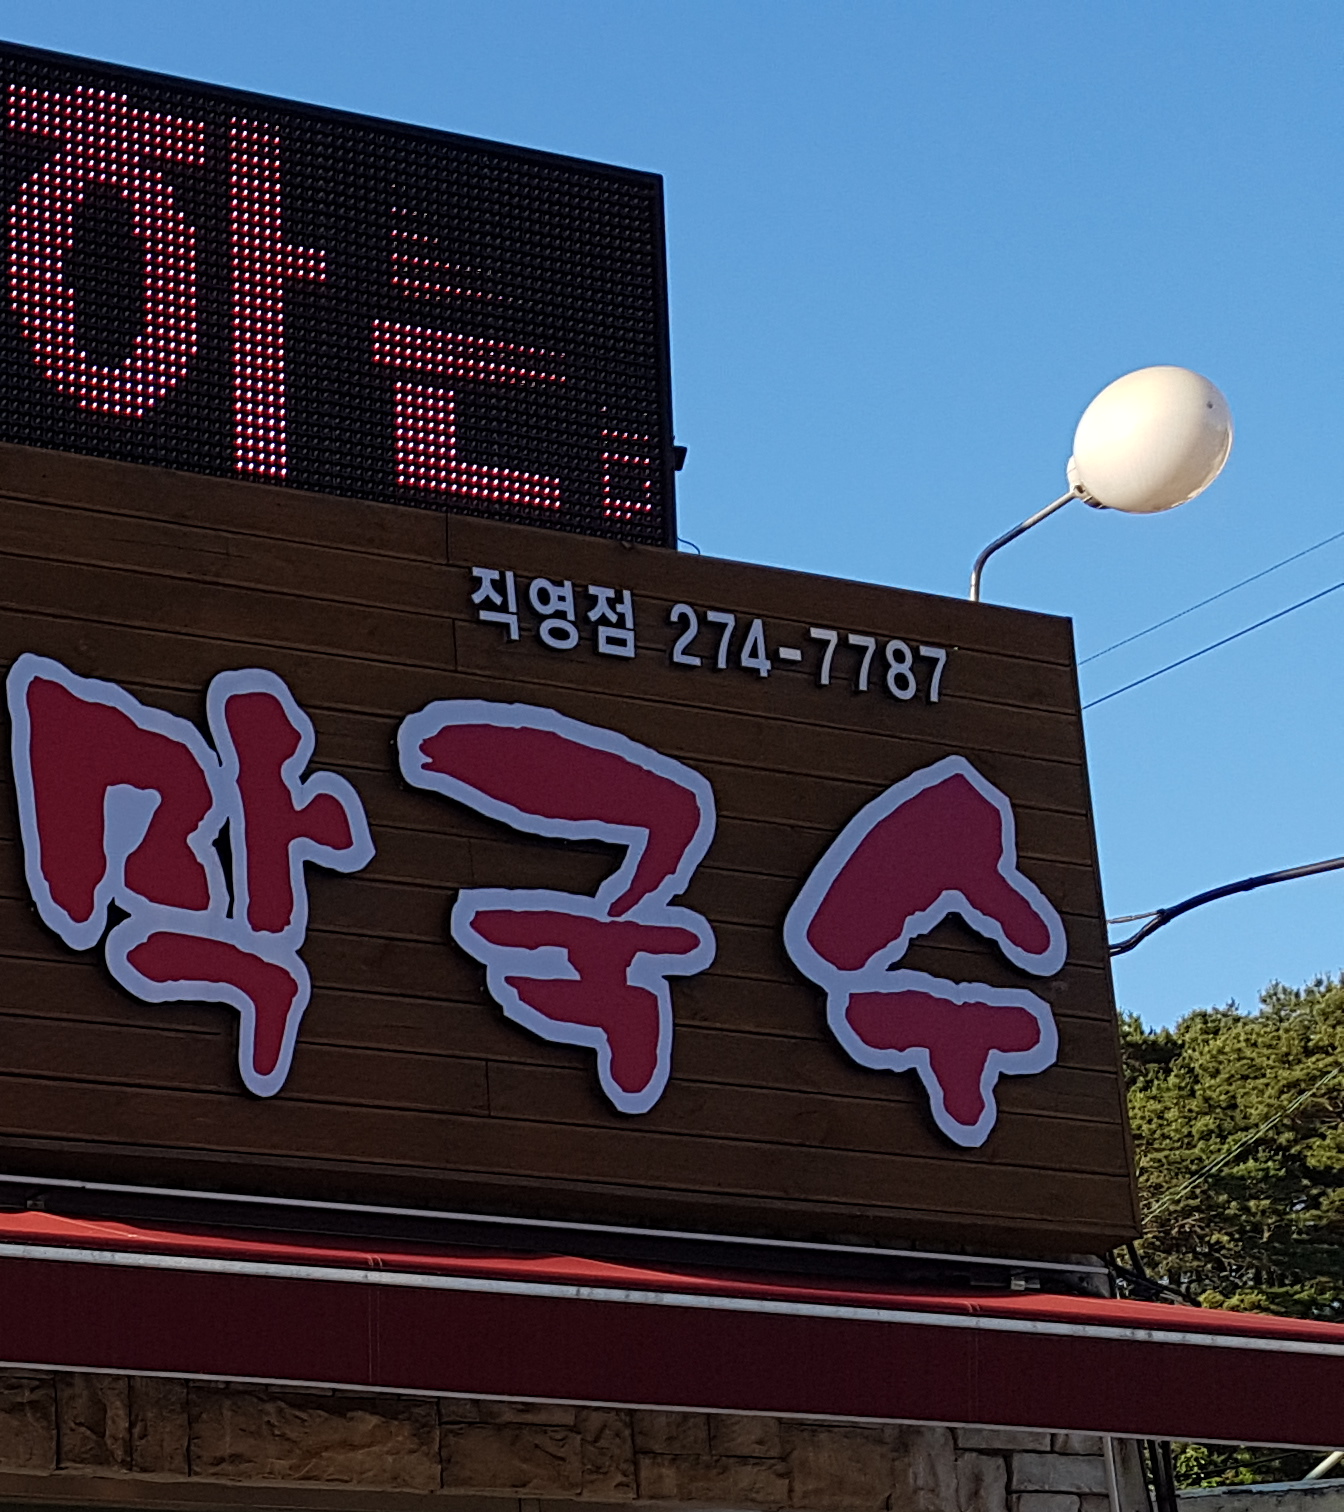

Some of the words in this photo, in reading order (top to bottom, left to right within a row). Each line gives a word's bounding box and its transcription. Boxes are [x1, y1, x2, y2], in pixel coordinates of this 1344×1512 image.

[471, 566, 636, 660] 직영점
[670, 603, 948, 703] 274-7787
[6, 652, 1068, 1148] 막국수
